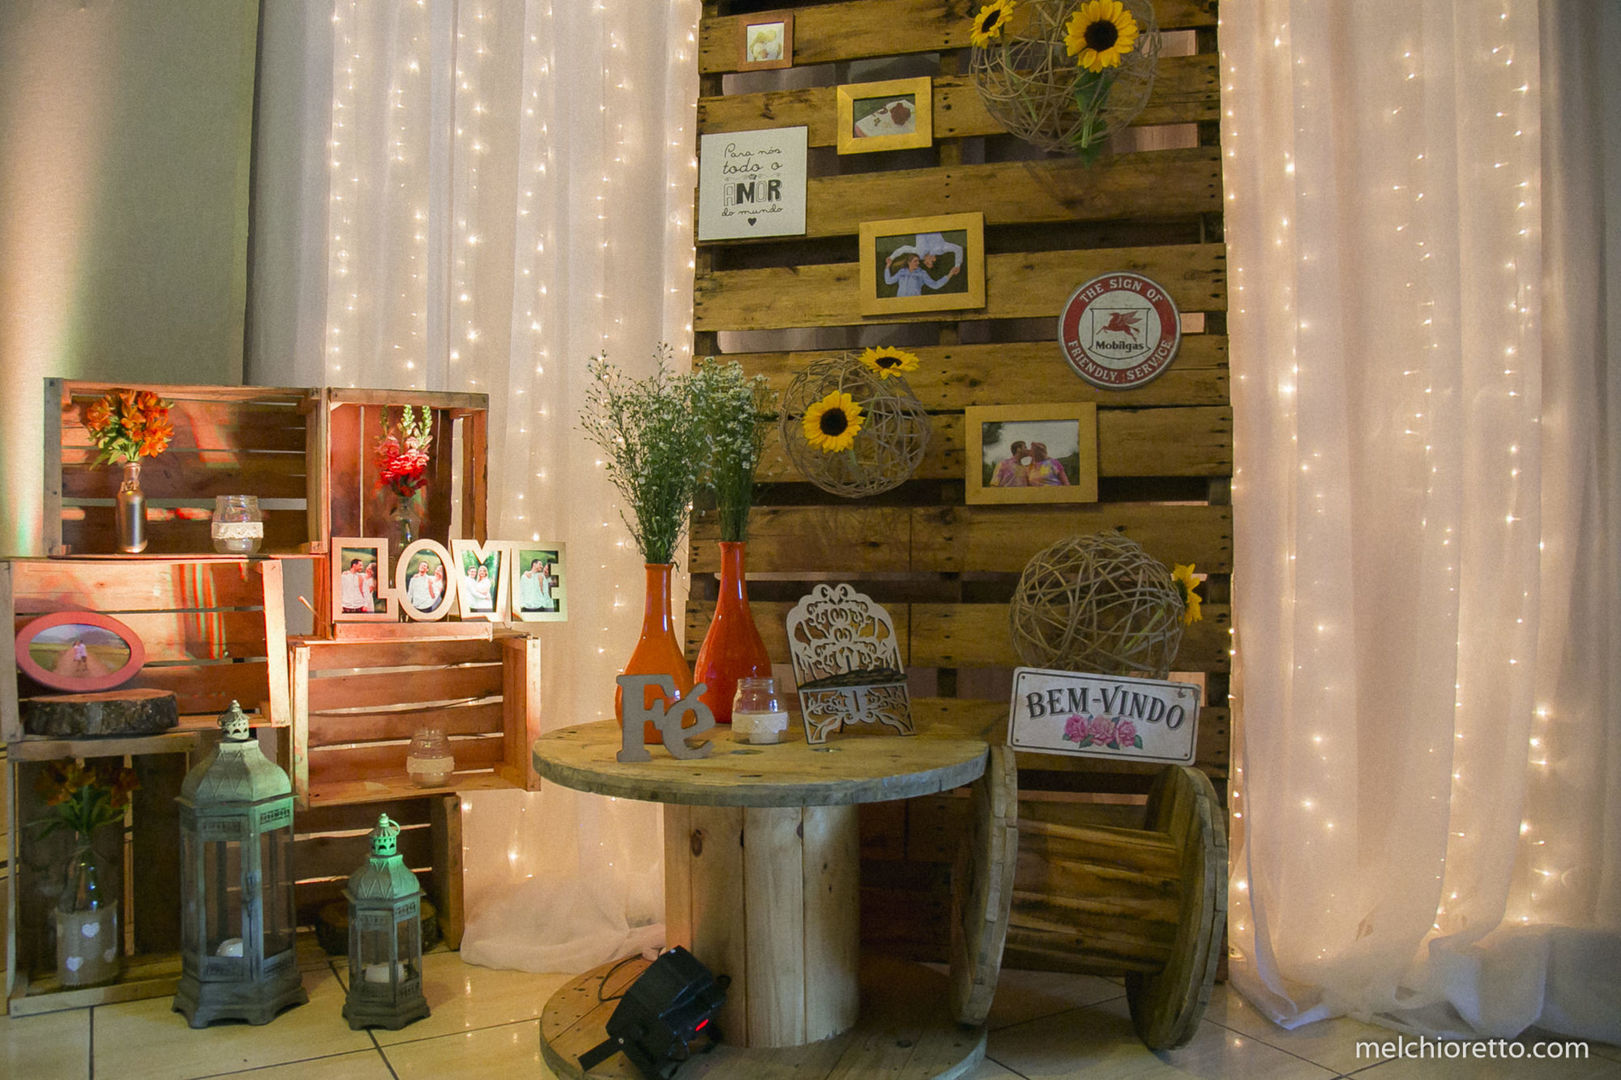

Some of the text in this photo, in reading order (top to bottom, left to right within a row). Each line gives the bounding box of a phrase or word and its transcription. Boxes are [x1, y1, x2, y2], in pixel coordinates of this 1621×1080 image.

[724, 143, 782, 158] Para nós
[723, 158, 783, 174] todo o
[723, 179, 782, 206] AMOR
[721, 204, 783, 216] do mundo
[1080, 278, 1163, 303] THE SIGN OF
[1095, 340, 1145, 353] Mobilgas
[1126, 339, 1173, 381] SERVICE
[331, 537, 568, 623] LOVE
[616, 674, 716, 762] Fé
[1026, 685, 1185, 729] BEM-VINDO
